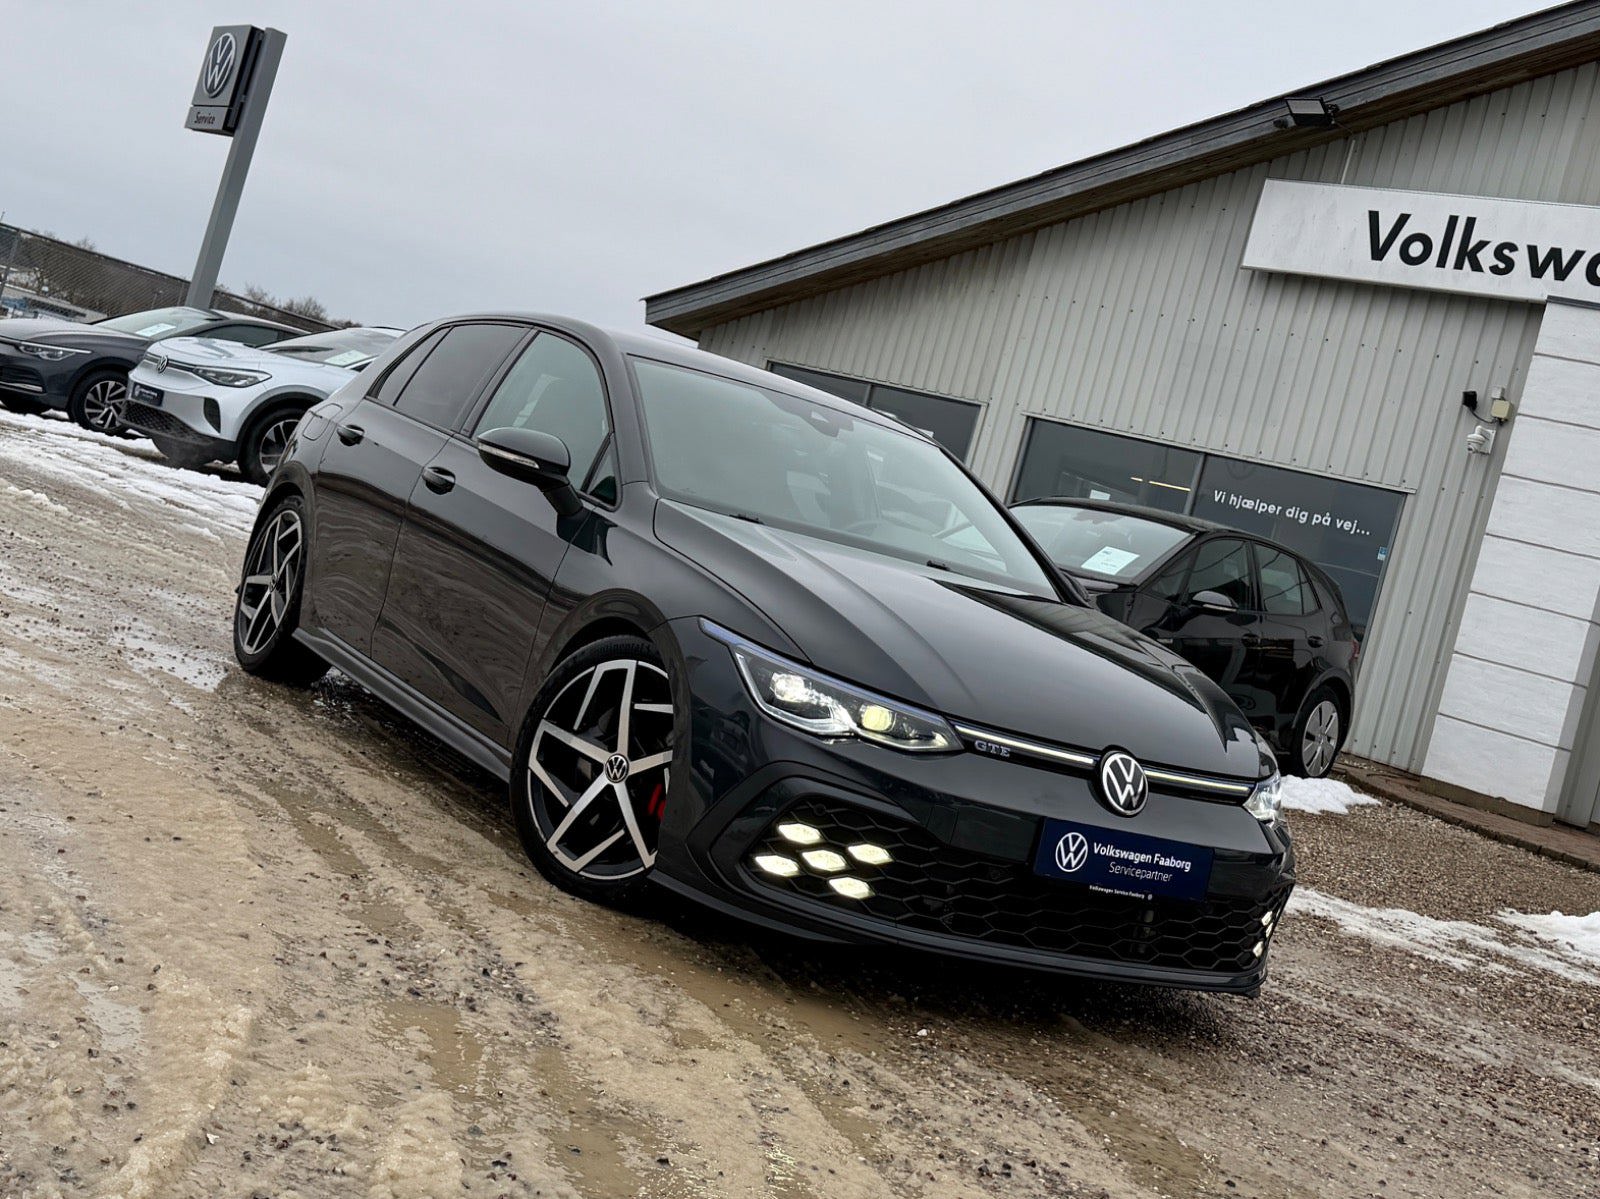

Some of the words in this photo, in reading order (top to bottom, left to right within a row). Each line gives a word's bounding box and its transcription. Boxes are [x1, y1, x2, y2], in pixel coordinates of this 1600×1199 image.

[194, 111, 215, 124] Service
[1214, 490, 1226, 503] Vi
[1229, 493, 1282, 515] hjælper
[1285, 505, 1308, 523] dig
[1311, 512, 1331, 527] på
[975, 740, 1011, 758] GTE
[1093, 842, 1152, 864] Volkswagen
[1153, 853, 1192, 872] Faaborg
[1108, 861, 1173, 882] Servicepartner
